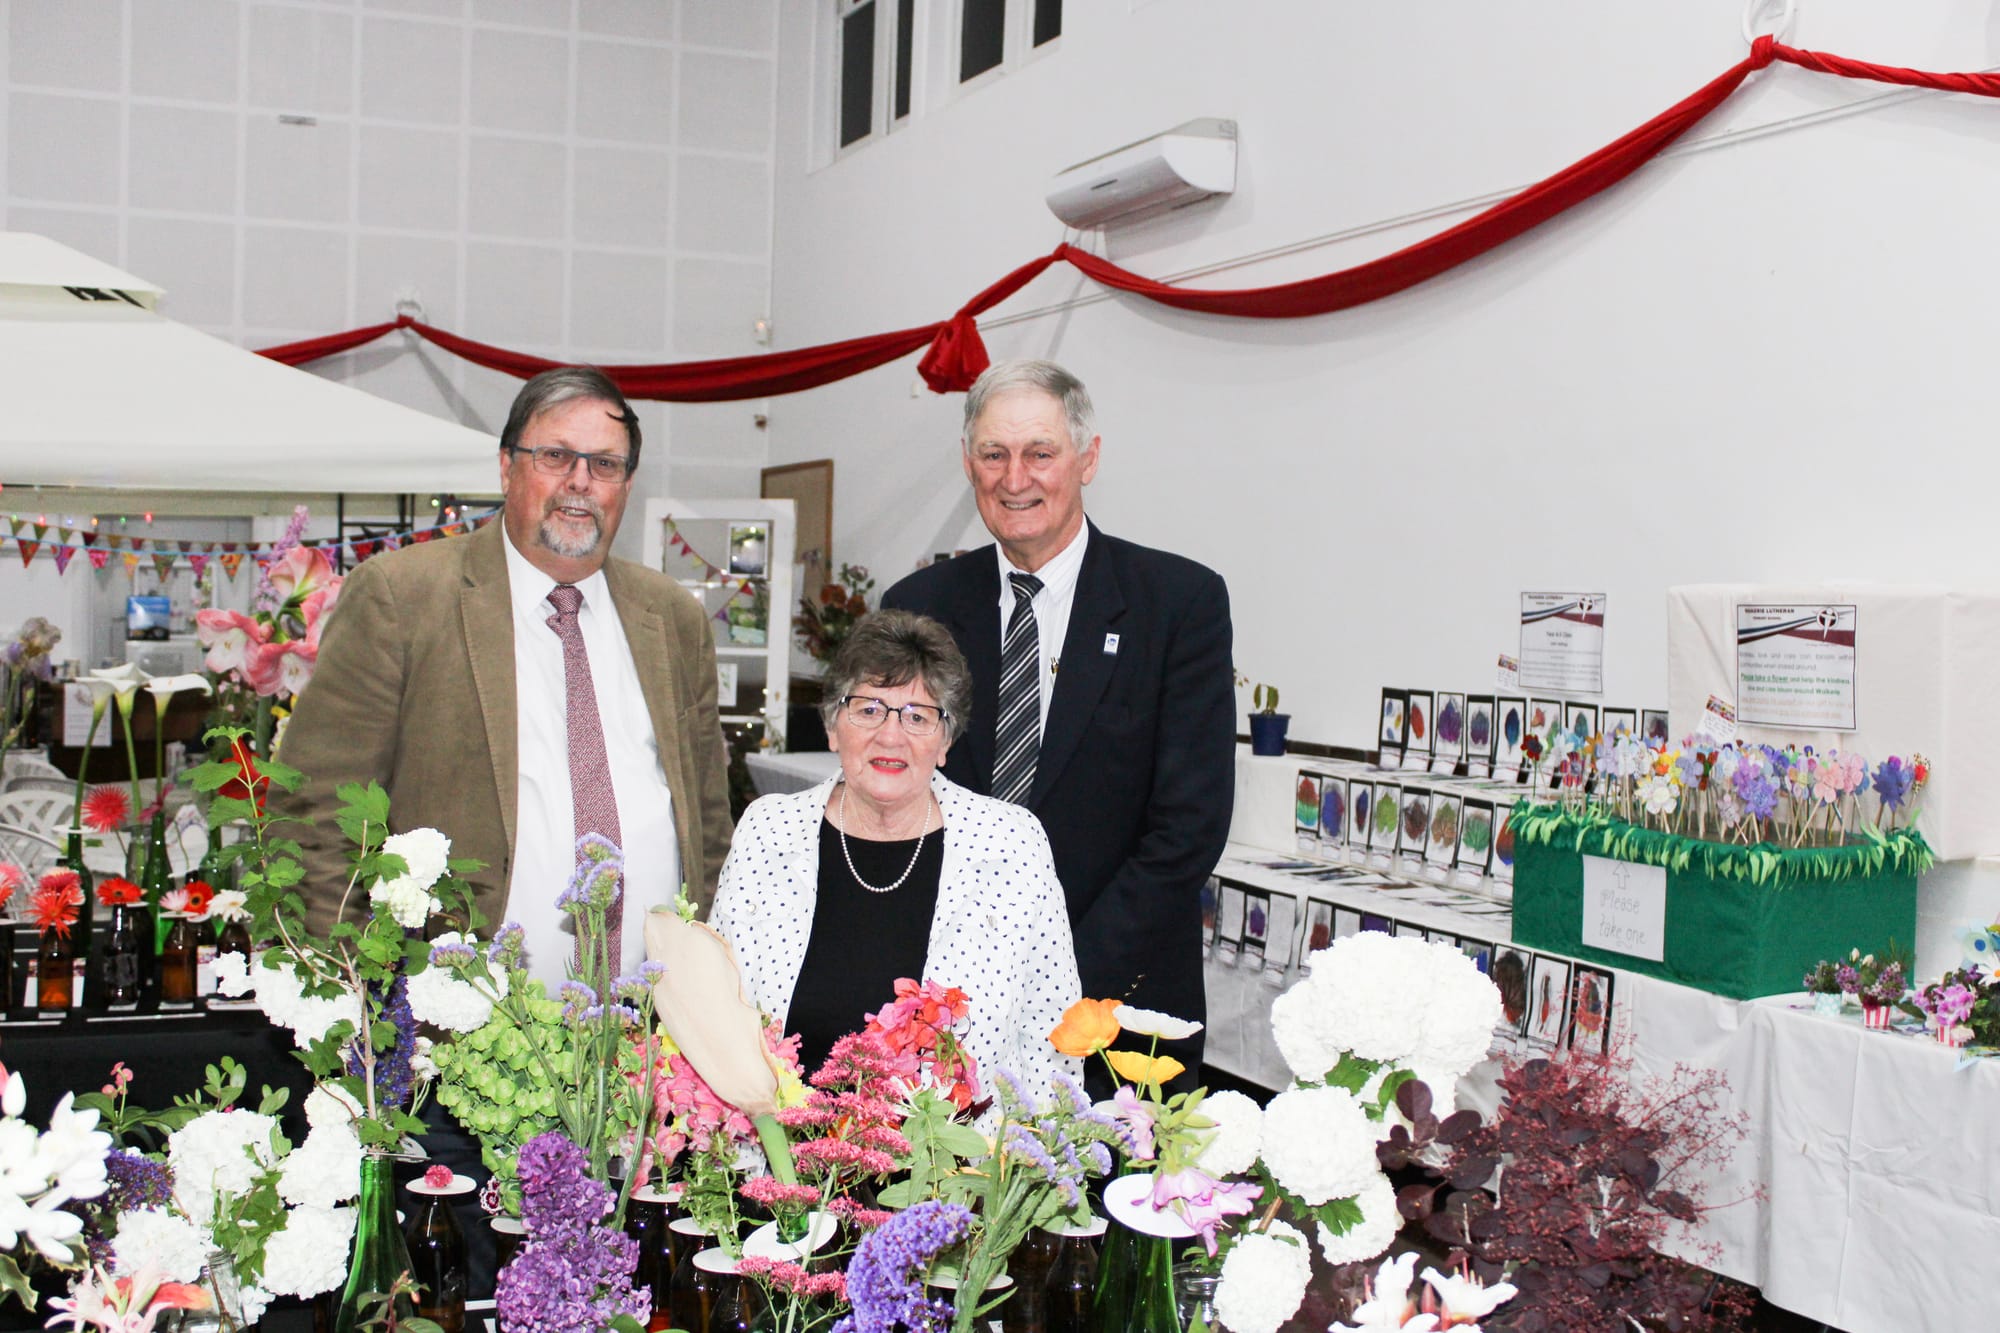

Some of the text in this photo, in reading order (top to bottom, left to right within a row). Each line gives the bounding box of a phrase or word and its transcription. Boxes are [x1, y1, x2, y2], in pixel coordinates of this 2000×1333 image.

[1600, 889, 1640, 915] Please
[1600, 913, 1647, 945] take one
